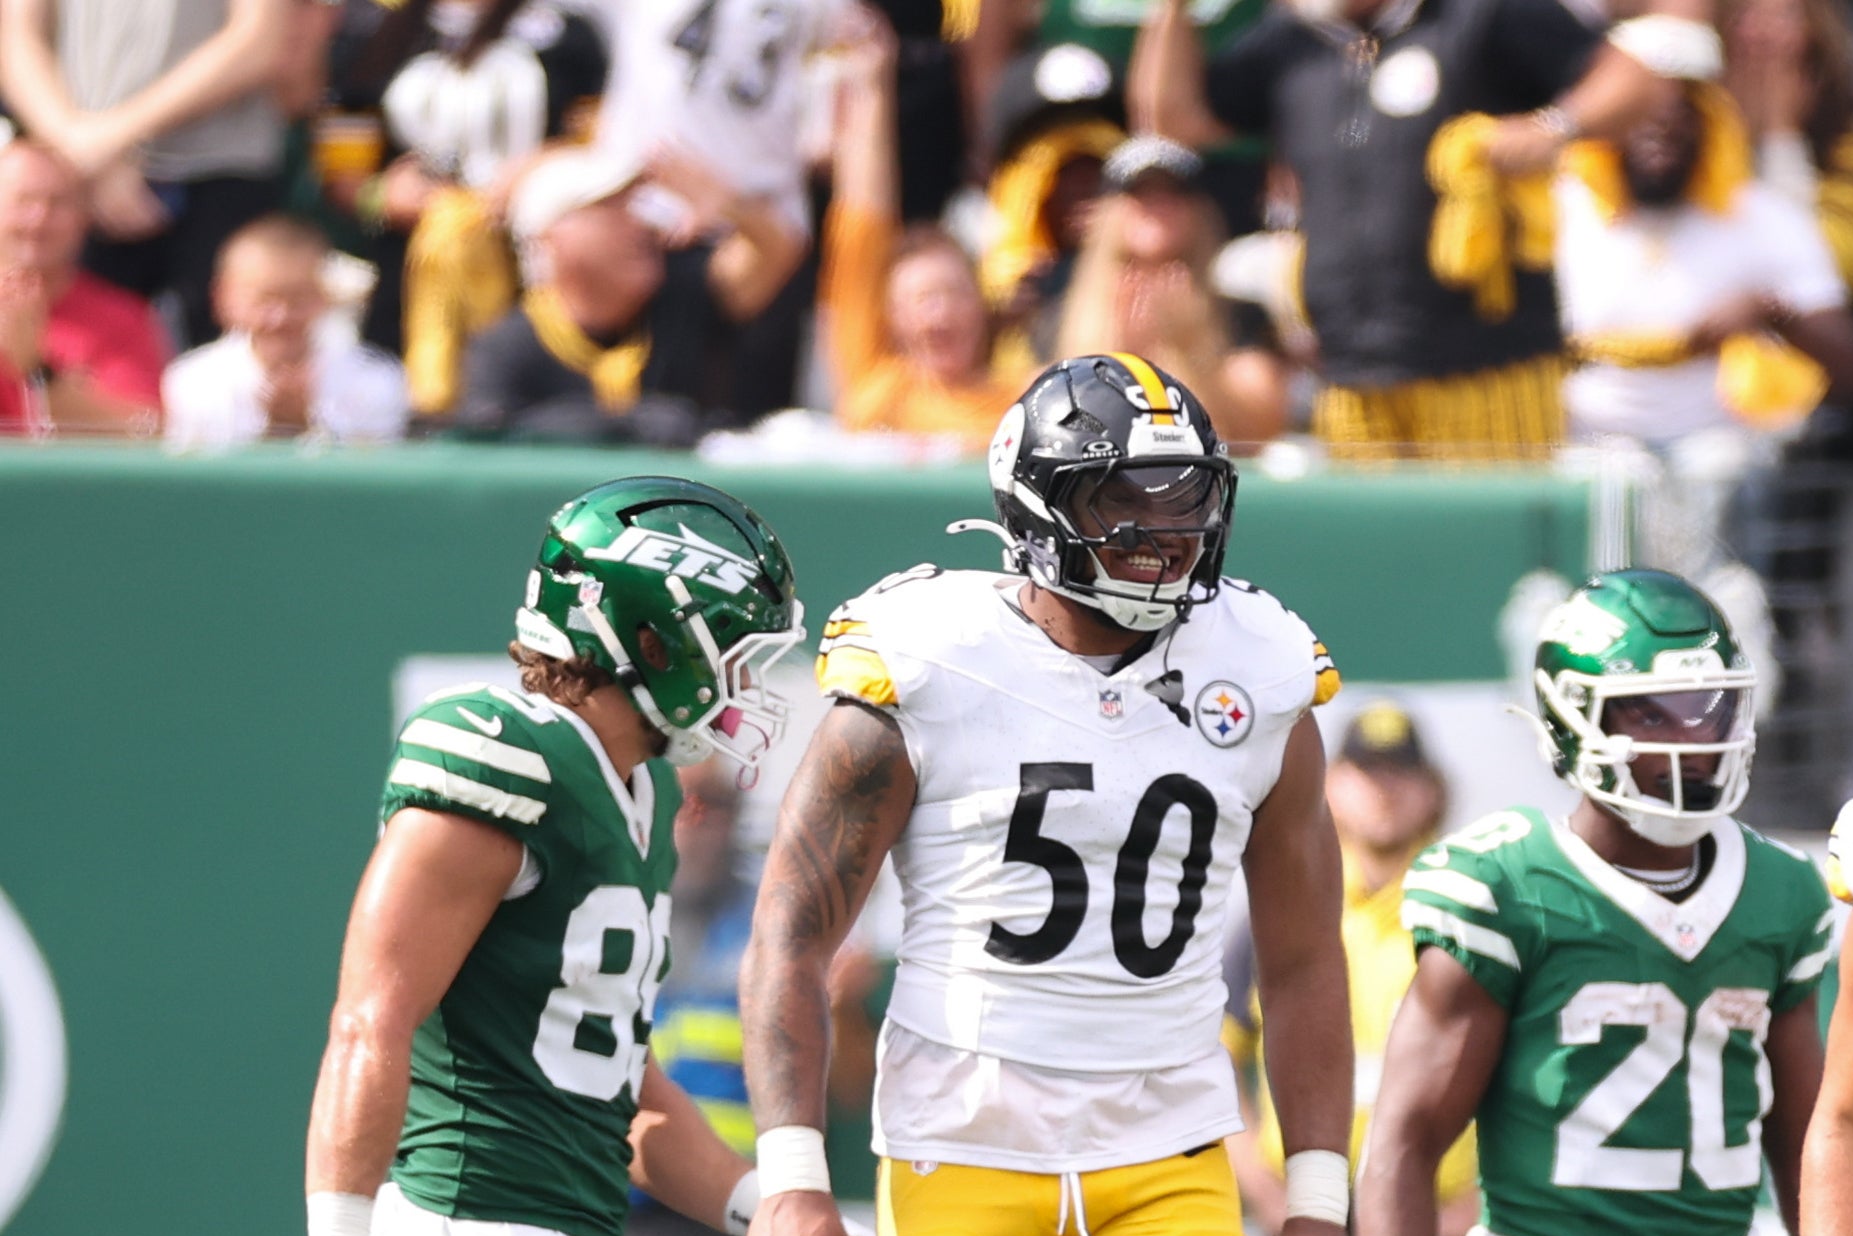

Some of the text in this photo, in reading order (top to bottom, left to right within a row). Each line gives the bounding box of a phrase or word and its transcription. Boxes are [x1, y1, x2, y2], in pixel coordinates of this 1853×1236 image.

[1124, 384, 1190, 428] 50
[582, 522, 763, 596] JETS
[984, 761, 1219, 980] 50
[1549, 980, 1775, 1192] 20
